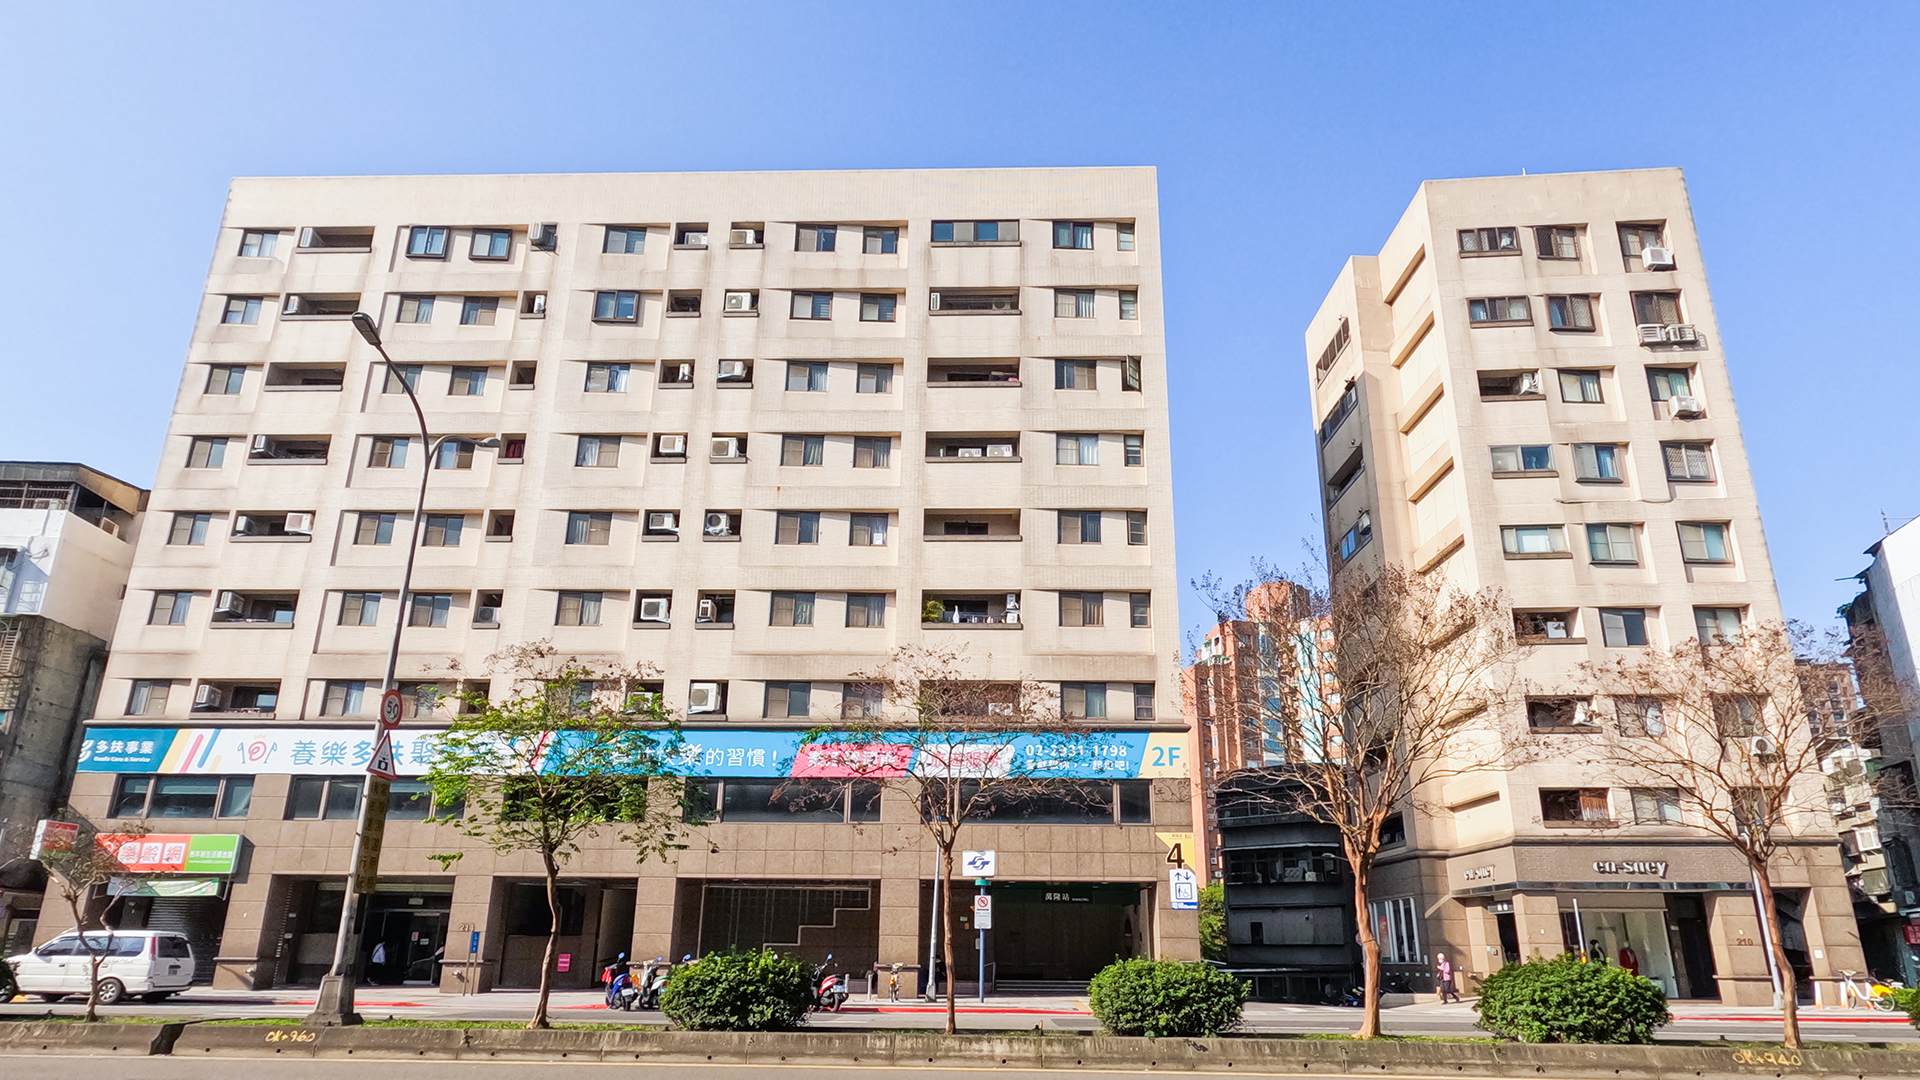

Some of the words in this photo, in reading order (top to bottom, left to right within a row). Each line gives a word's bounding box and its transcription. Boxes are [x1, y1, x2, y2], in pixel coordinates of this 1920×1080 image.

[386, 700, 399, 720] 50
[95, 740, 155, 754] 多扶事業
[1152, 746, 1181, 767] 2F
[1166, 842, 1186, 869] 4
[1736, 937, 1753, 946] 210
